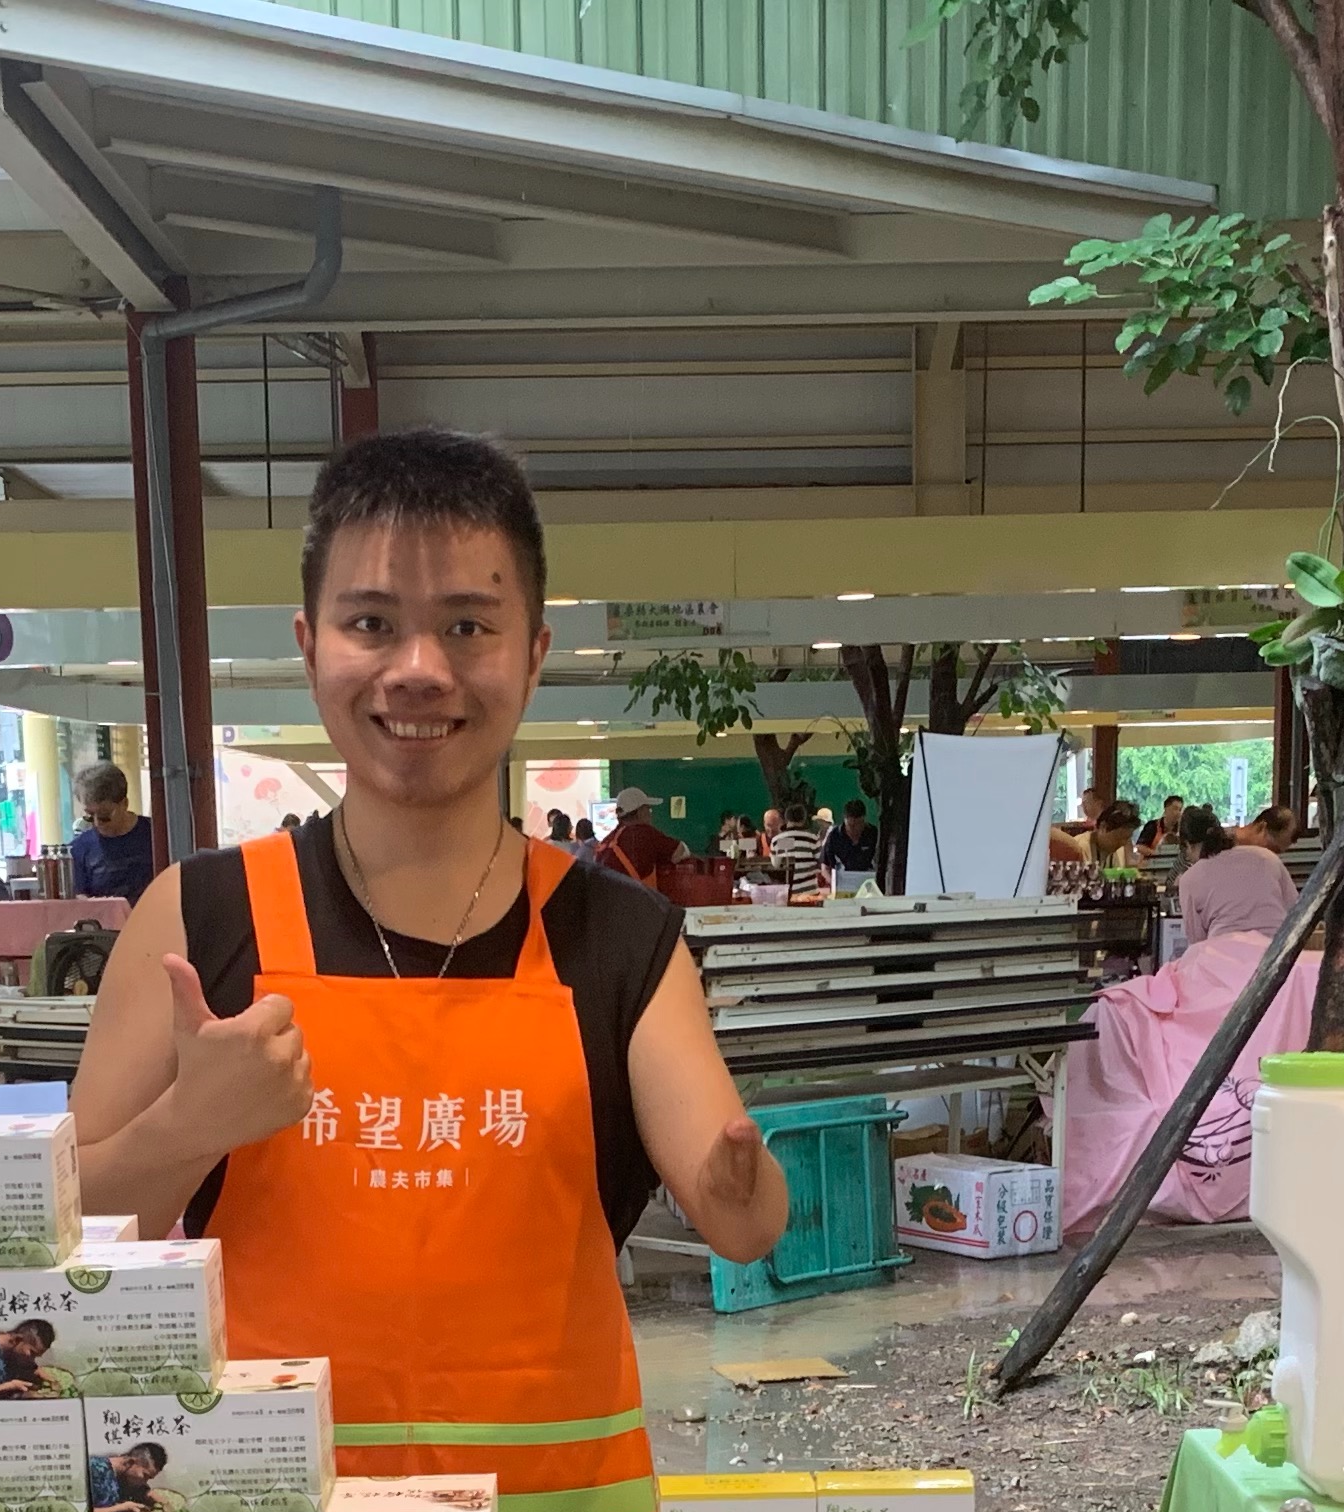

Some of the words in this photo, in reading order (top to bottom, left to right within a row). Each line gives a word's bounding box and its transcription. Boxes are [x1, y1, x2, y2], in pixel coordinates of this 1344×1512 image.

[222, 726, 236, 743] D
[302, 1087, 529, 1152] 希望廣場
[369, 1168, 454, 1189] 農夫市集
